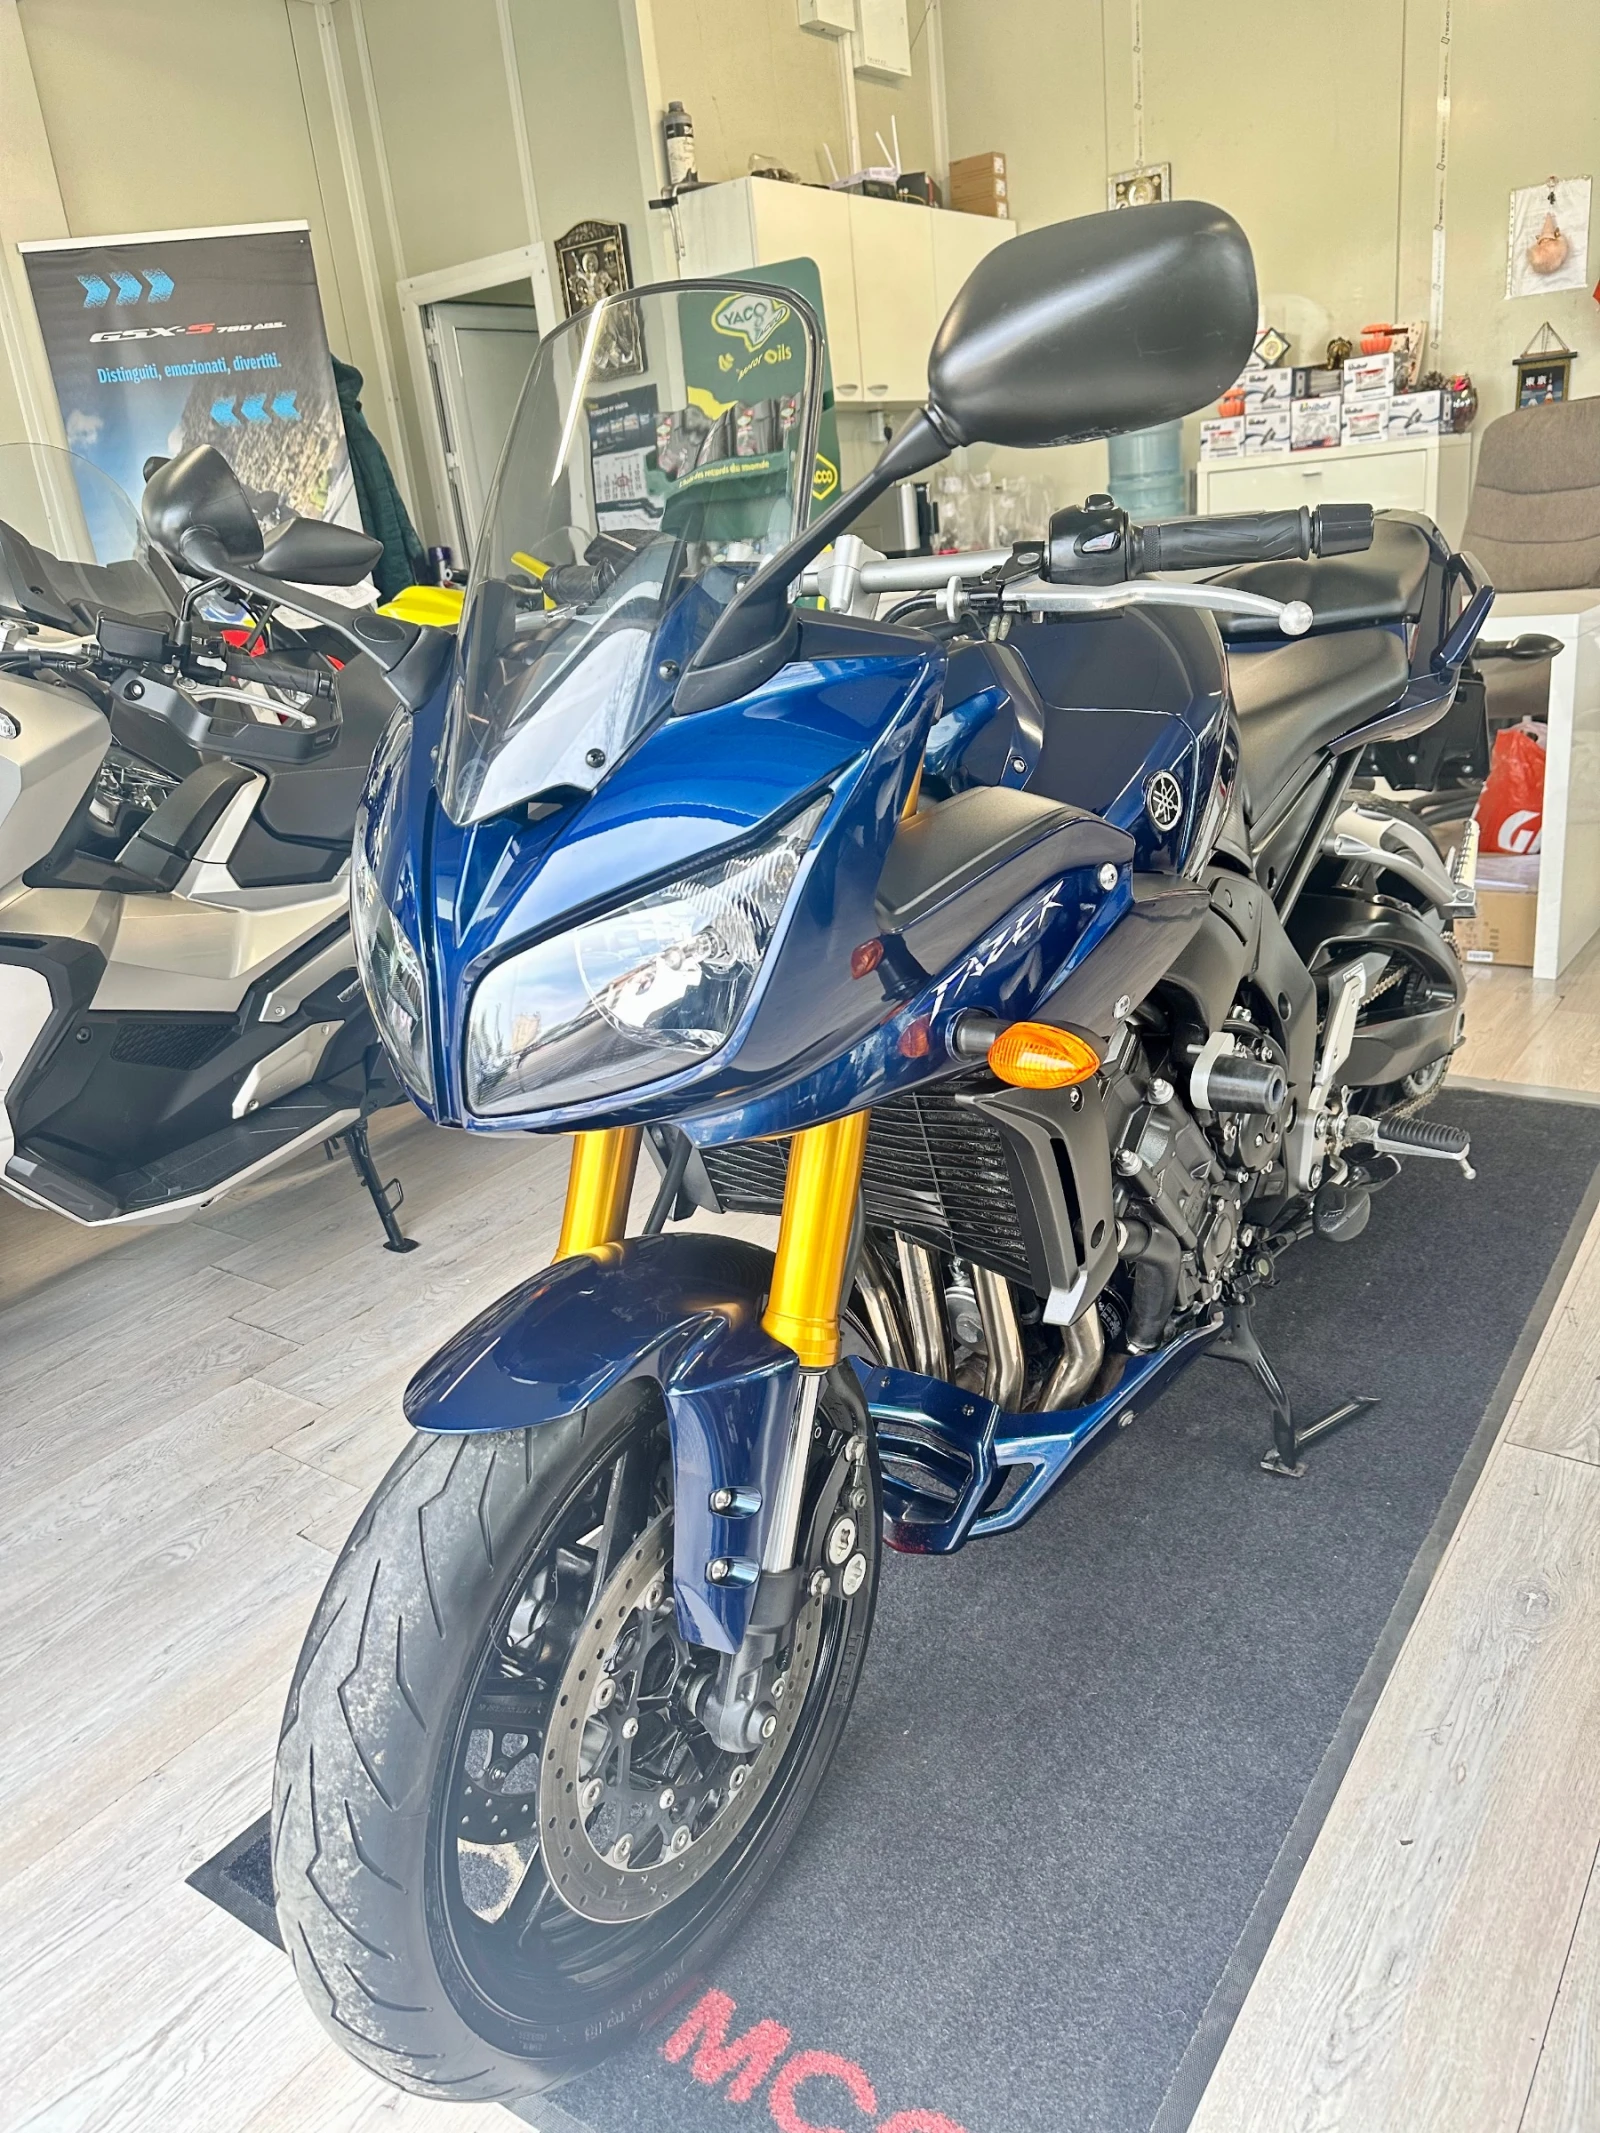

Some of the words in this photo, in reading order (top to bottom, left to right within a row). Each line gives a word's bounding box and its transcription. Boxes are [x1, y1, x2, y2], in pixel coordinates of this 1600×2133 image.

[89, 322, 215, 343] GSX-S
[764, 343, 792, 364] Oils
[97, 363, 162, 384] Distinguiti,
[164, 356, 231, 378] emozionati,
[233, 352, 282, 372] divertiti.
